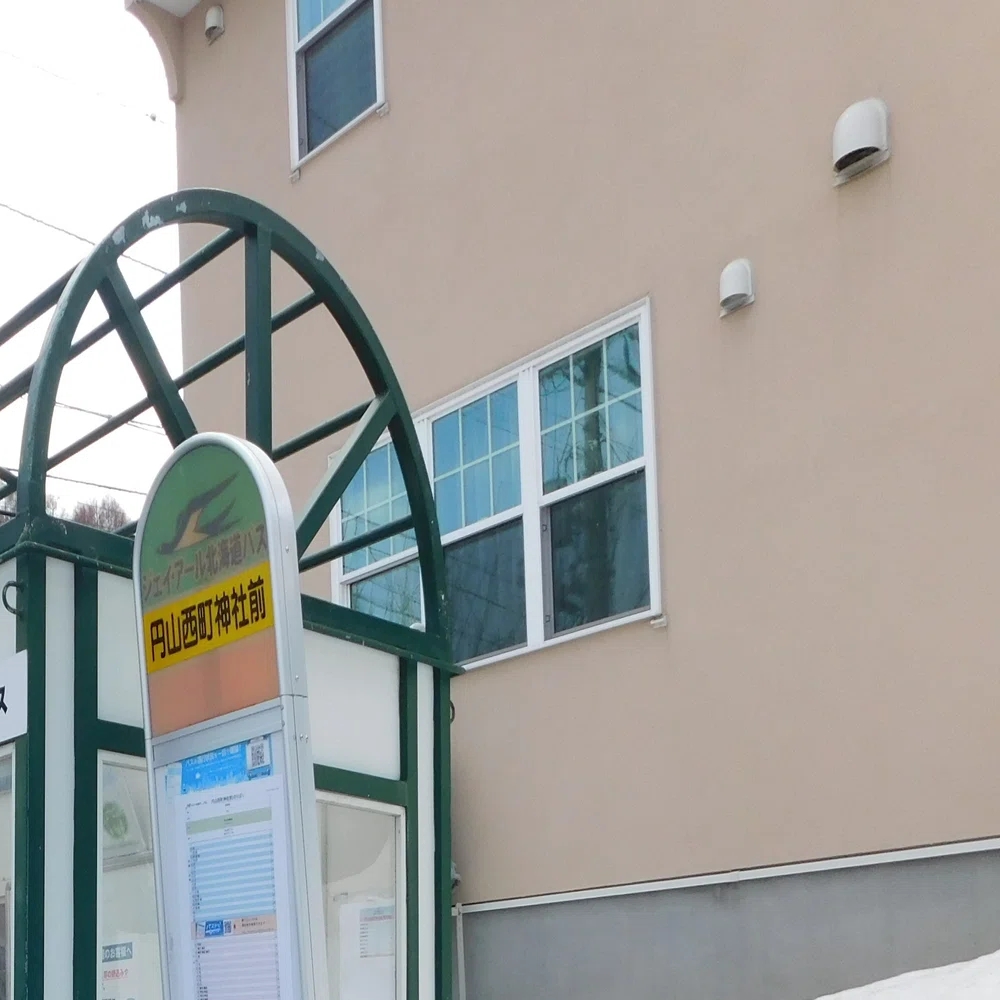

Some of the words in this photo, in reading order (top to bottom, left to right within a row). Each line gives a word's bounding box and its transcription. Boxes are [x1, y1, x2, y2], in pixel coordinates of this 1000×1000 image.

[149, 575, 266, 662] 円山西町神社前
